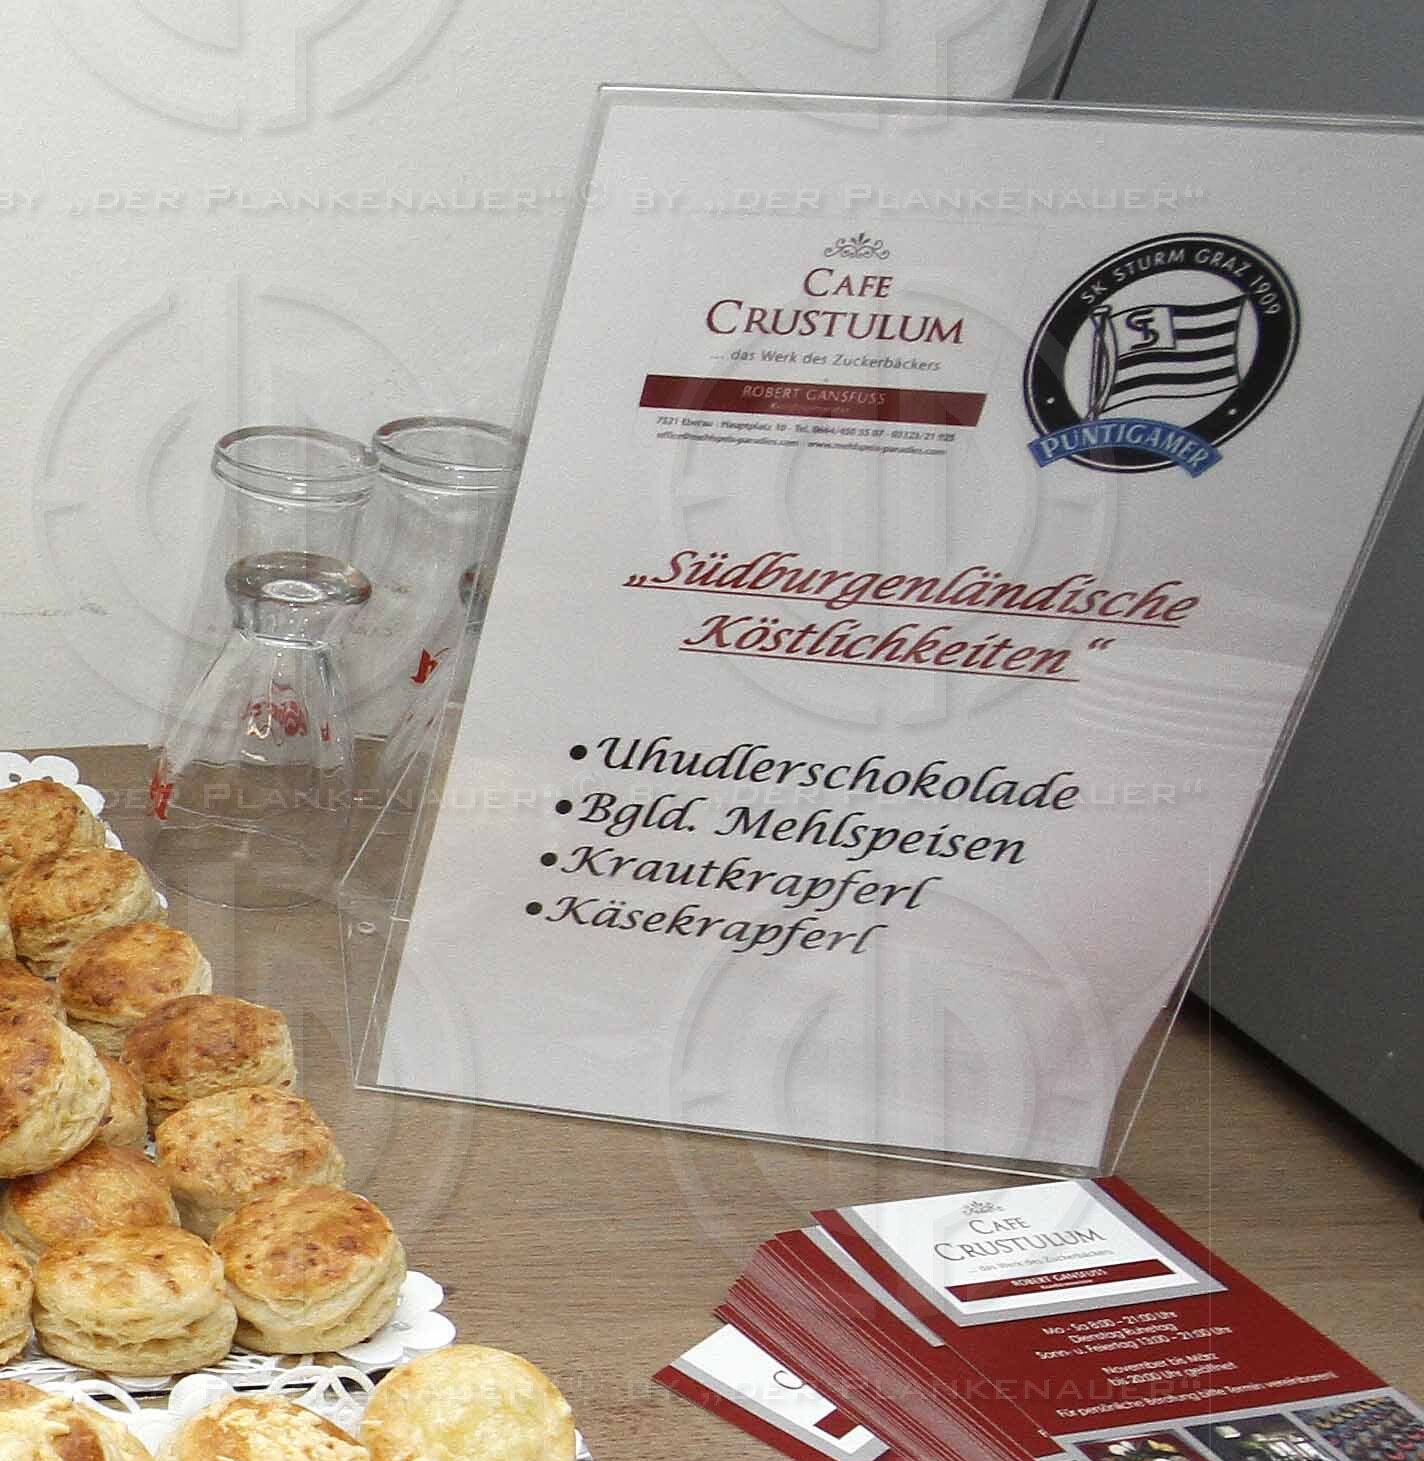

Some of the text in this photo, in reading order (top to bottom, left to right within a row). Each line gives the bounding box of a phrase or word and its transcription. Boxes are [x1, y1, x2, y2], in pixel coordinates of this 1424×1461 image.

[1080, 247, 1282, 317] SK STURM GRAZ 1909
[705, 298, 967, 345] CRUSTULUM
[730, 349, 755, 361] das
[760, 349, 798, 364] Werk
[801, 351, 828, 366] des
[741, 384, 801, 400] ROBERT
[1038, 423, 1210, 468] PUNTIGAMER
[596, 735, 1081, 811] Uhudlerschokolade
[577, 791, 1028, 866] Bgld. Mehlspeisen
[560, 845, 944, 913] Krautkrapferl
[545, 895, 890, 957] Käsekrapferl
[933, 1226, 1108, 1262] CRUSTULUM
